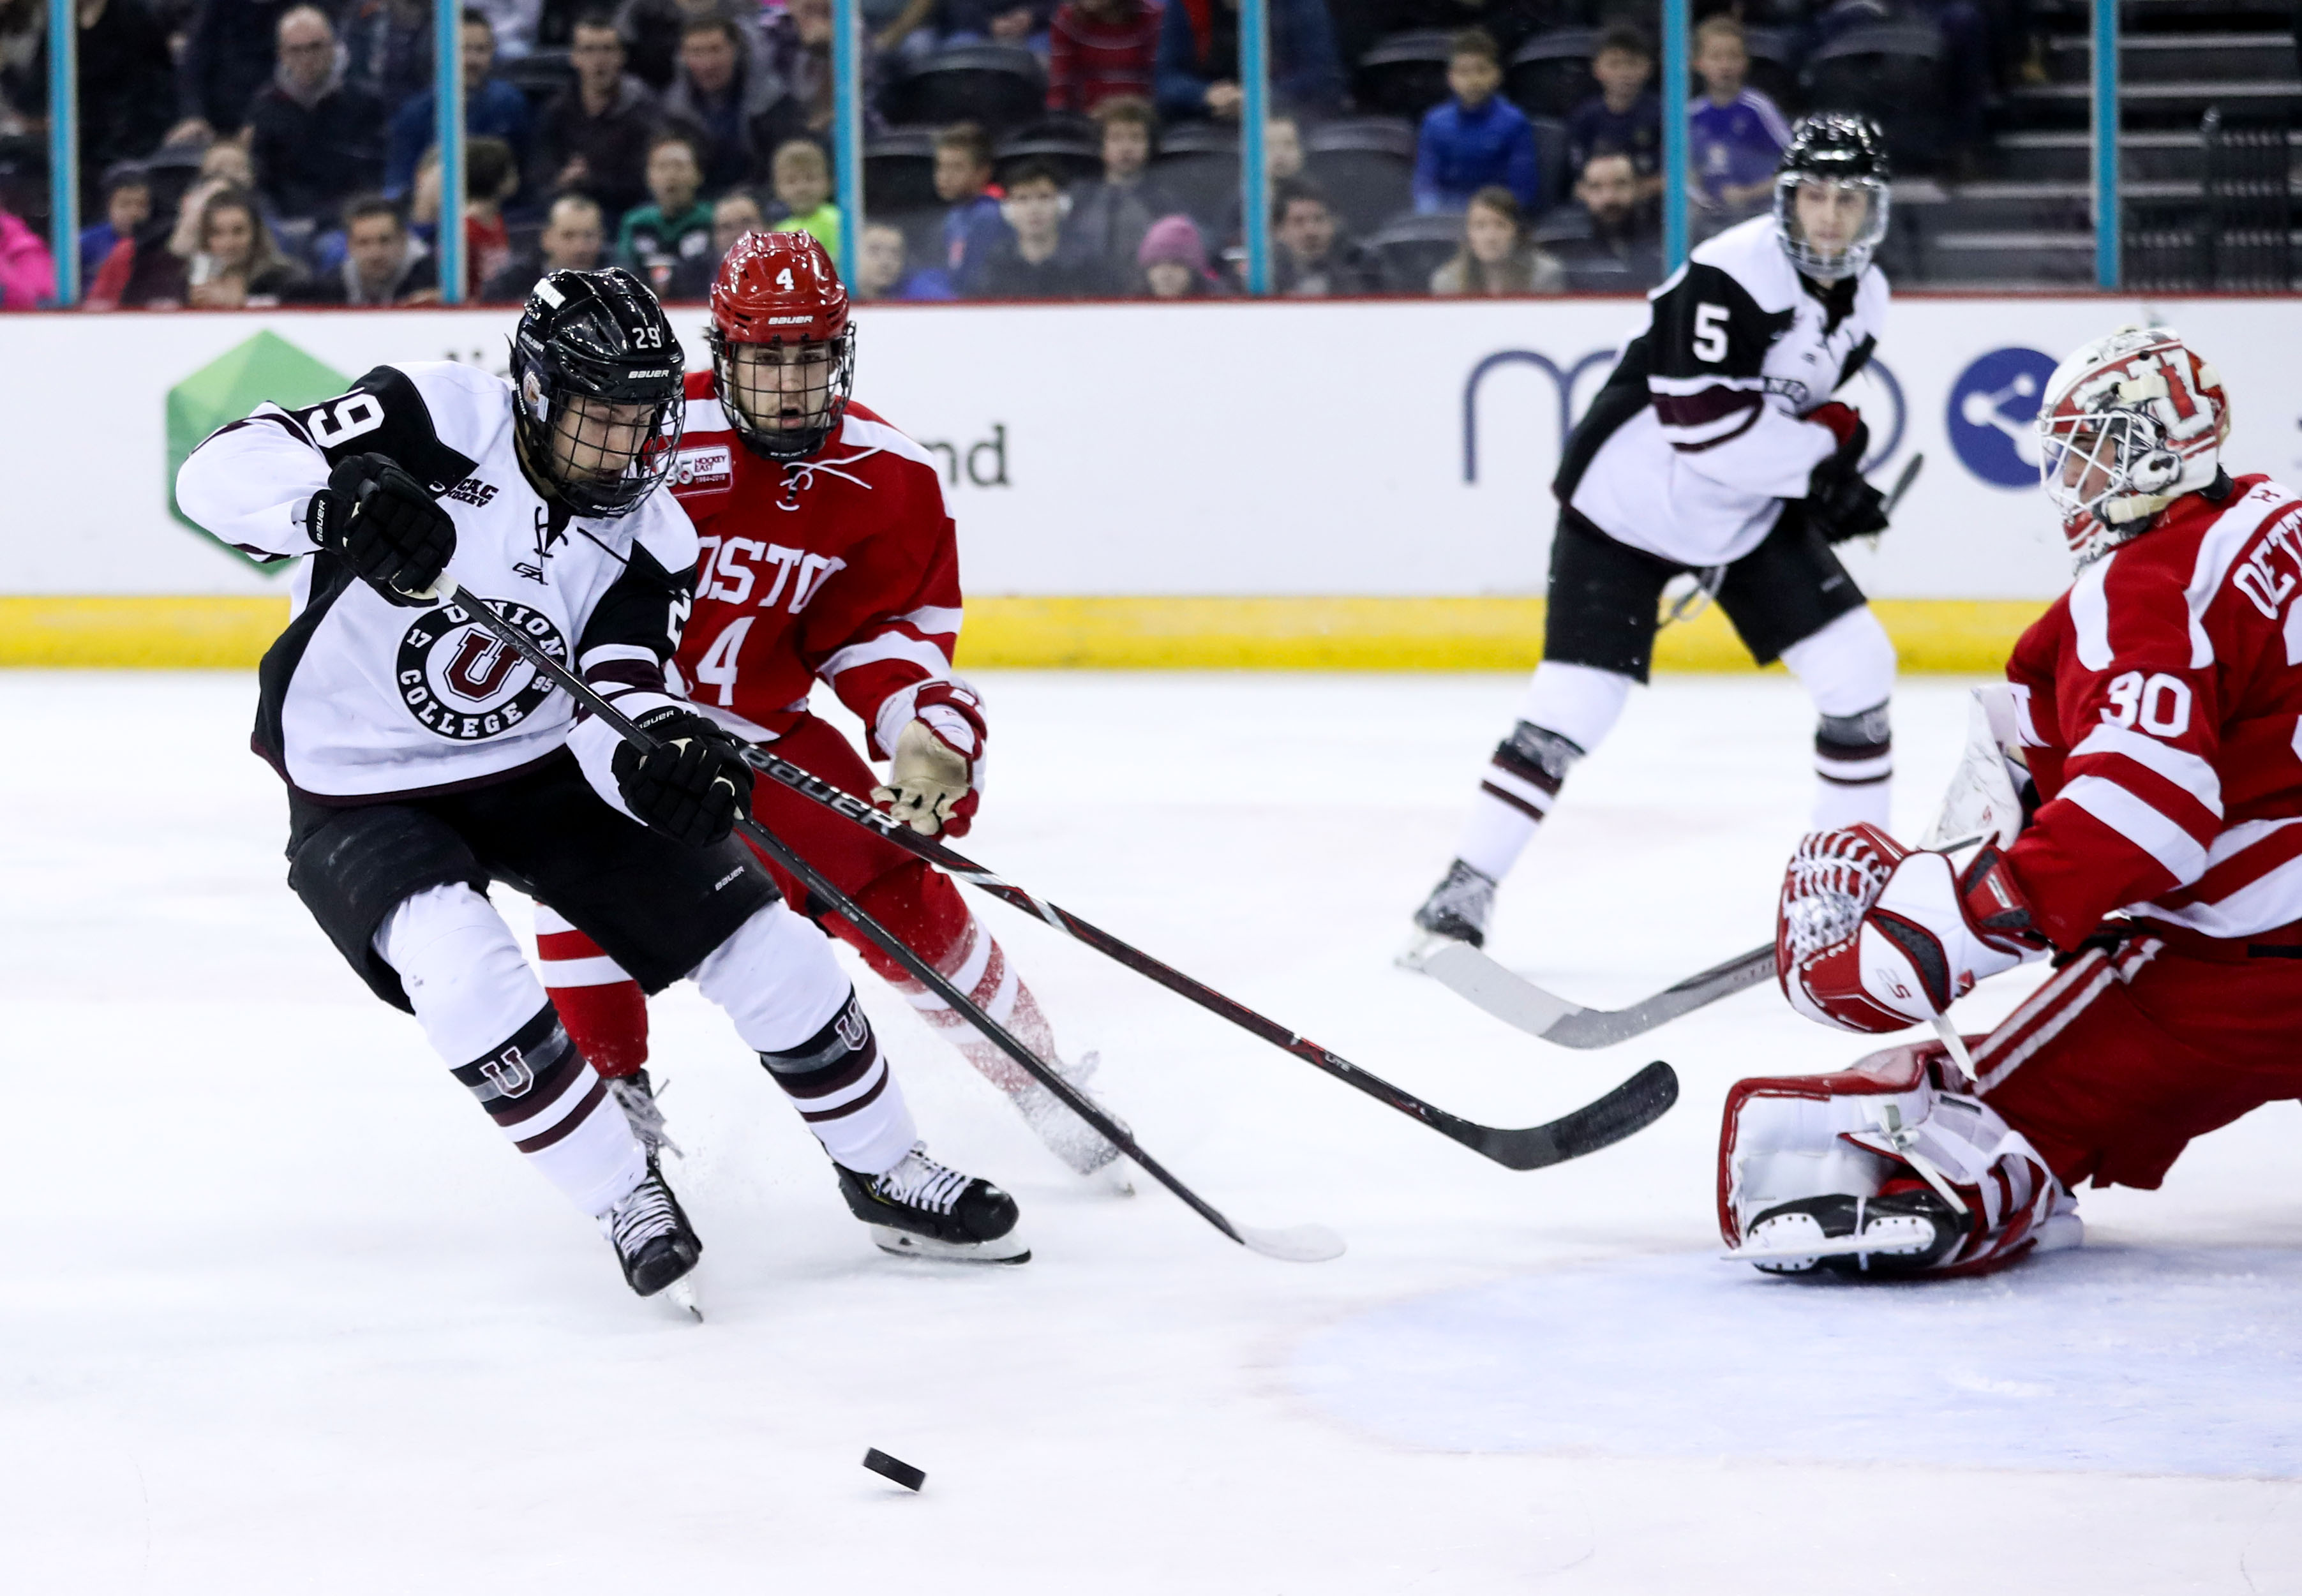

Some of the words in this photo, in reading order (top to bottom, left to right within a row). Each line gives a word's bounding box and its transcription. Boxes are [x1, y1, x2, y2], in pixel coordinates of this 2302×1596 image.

[776, 268, 795, 290] 4
[768, 315, 813, 325] BAUER
[1693, 302, 1730, 364] 5
[632, 327, 662, 349] 29
[627, 369, 669, 378] BAUER
[694, 454, 726, 464] HOCKEY
[694, 464, 713, 472] EAST
[316, 500, 326, 542] BAUER
[407, 628, 433, 648] 17
[489, 623, 543, 665] NEXUS
[444, 627, 525, 703] U
[695, 616, 756, 706] 4
[531, 676, 555, 693] 95
[400, 669, 524, 737] COLLEGE
[2100, 670, 2192, 738] 30
[715, 865, 745, 891] BAUER
[479, 1047, 534, 1099] U
